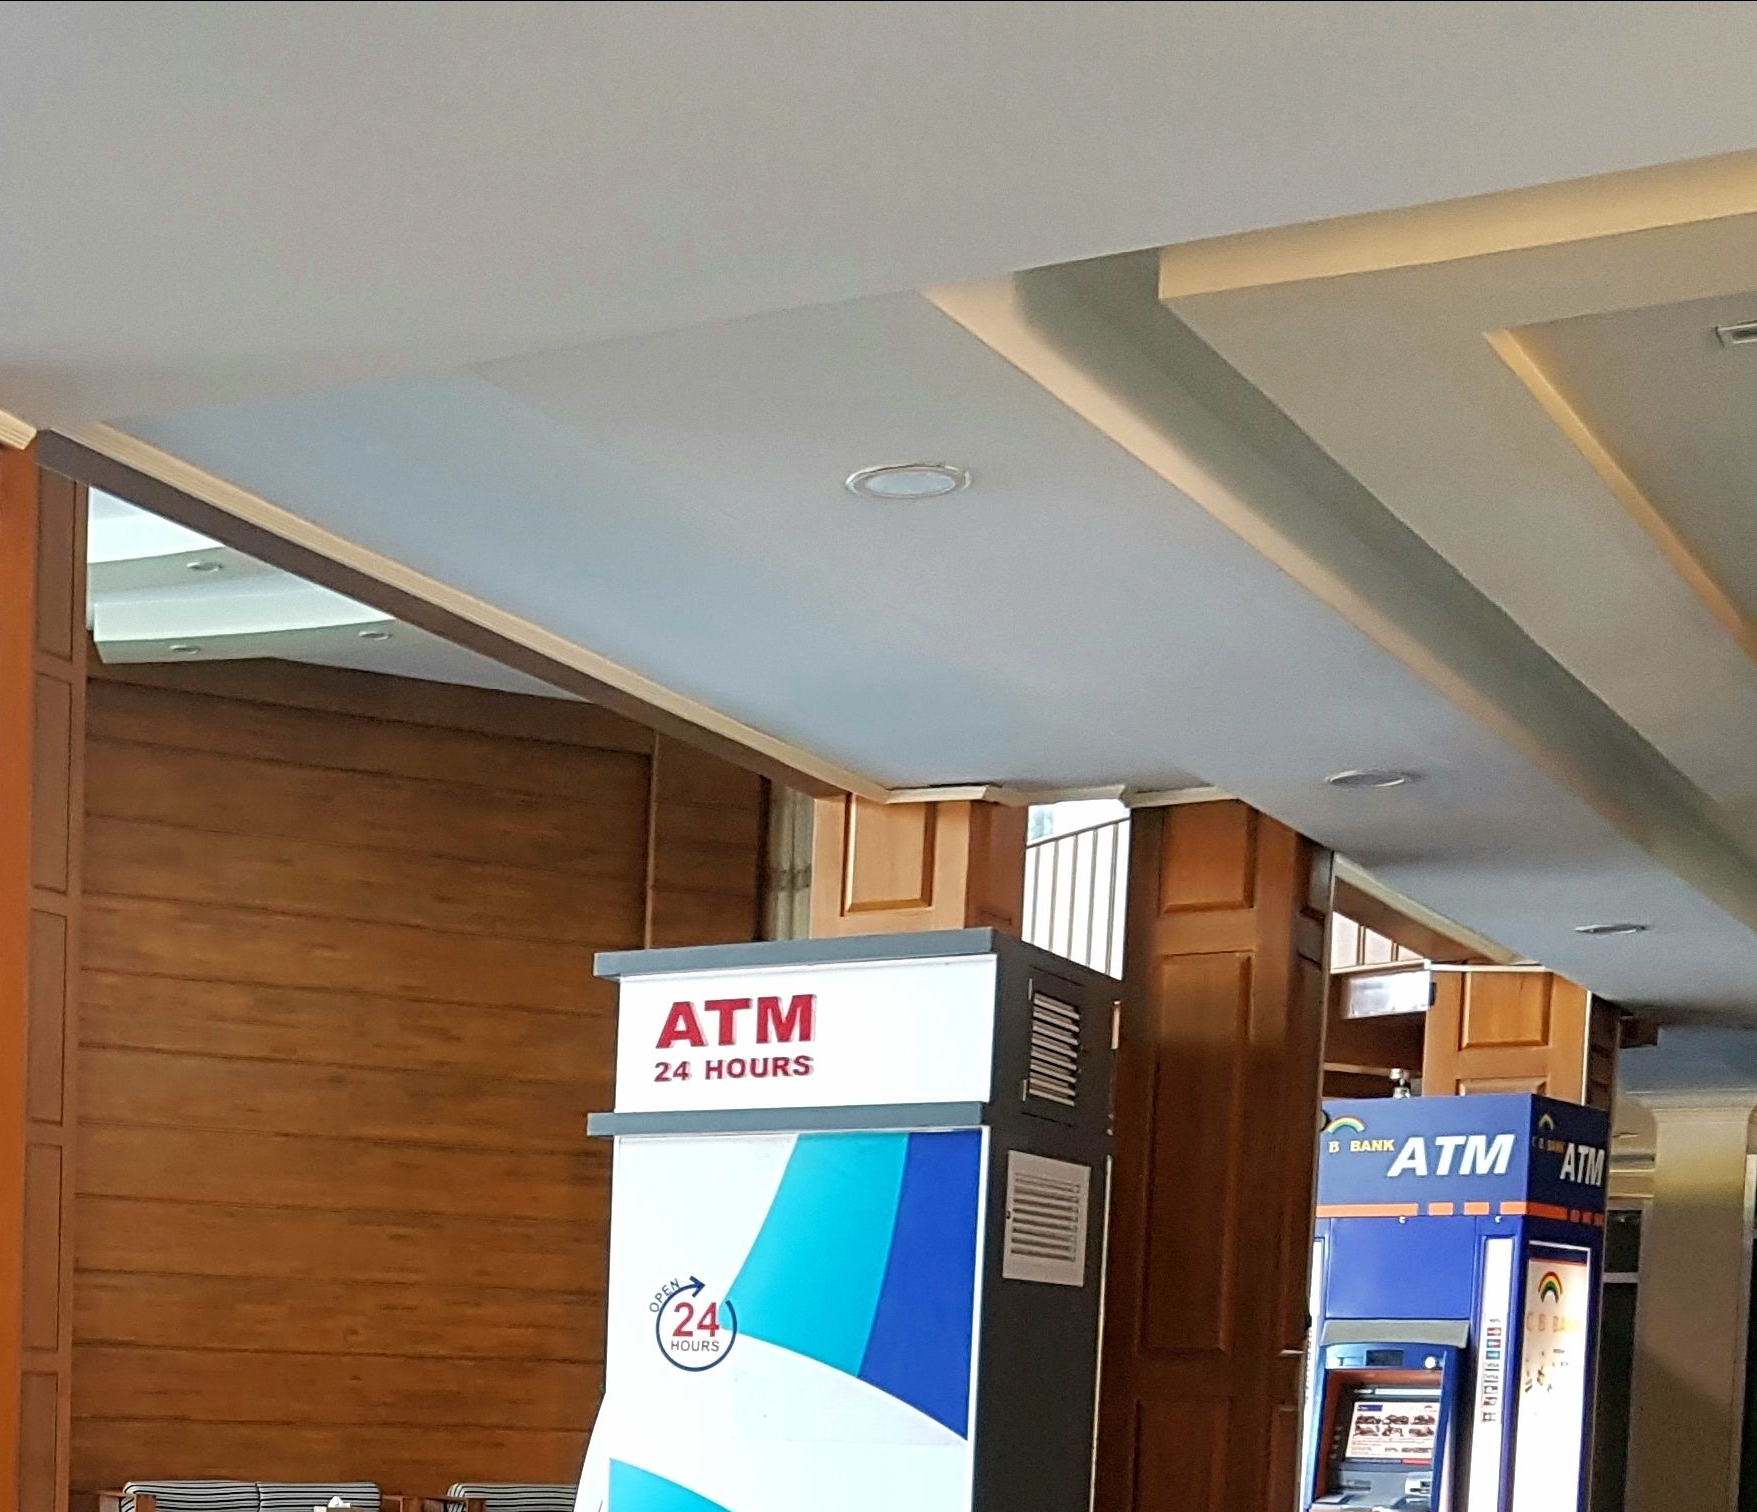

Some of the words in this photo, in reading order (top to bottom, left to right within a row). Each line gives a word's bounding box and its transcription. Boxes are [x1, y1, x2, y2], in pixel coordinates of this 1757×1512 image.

[655, 993, 816, 1050] ATM
[654, 1060, 691, 1083] 24
[705, 1054, 814, 1080] HOURS
[1349, 1139, 1395, 1153] BANK
[1386, 1133, 1515, 1178] ATM
[1559, 1142, 1605, 1187] ATM
[649, 1277, 681, 1313] OPEN
[672, 1301, 720, 1337] 24
[670, 1339, 720, 1352] HOURS
